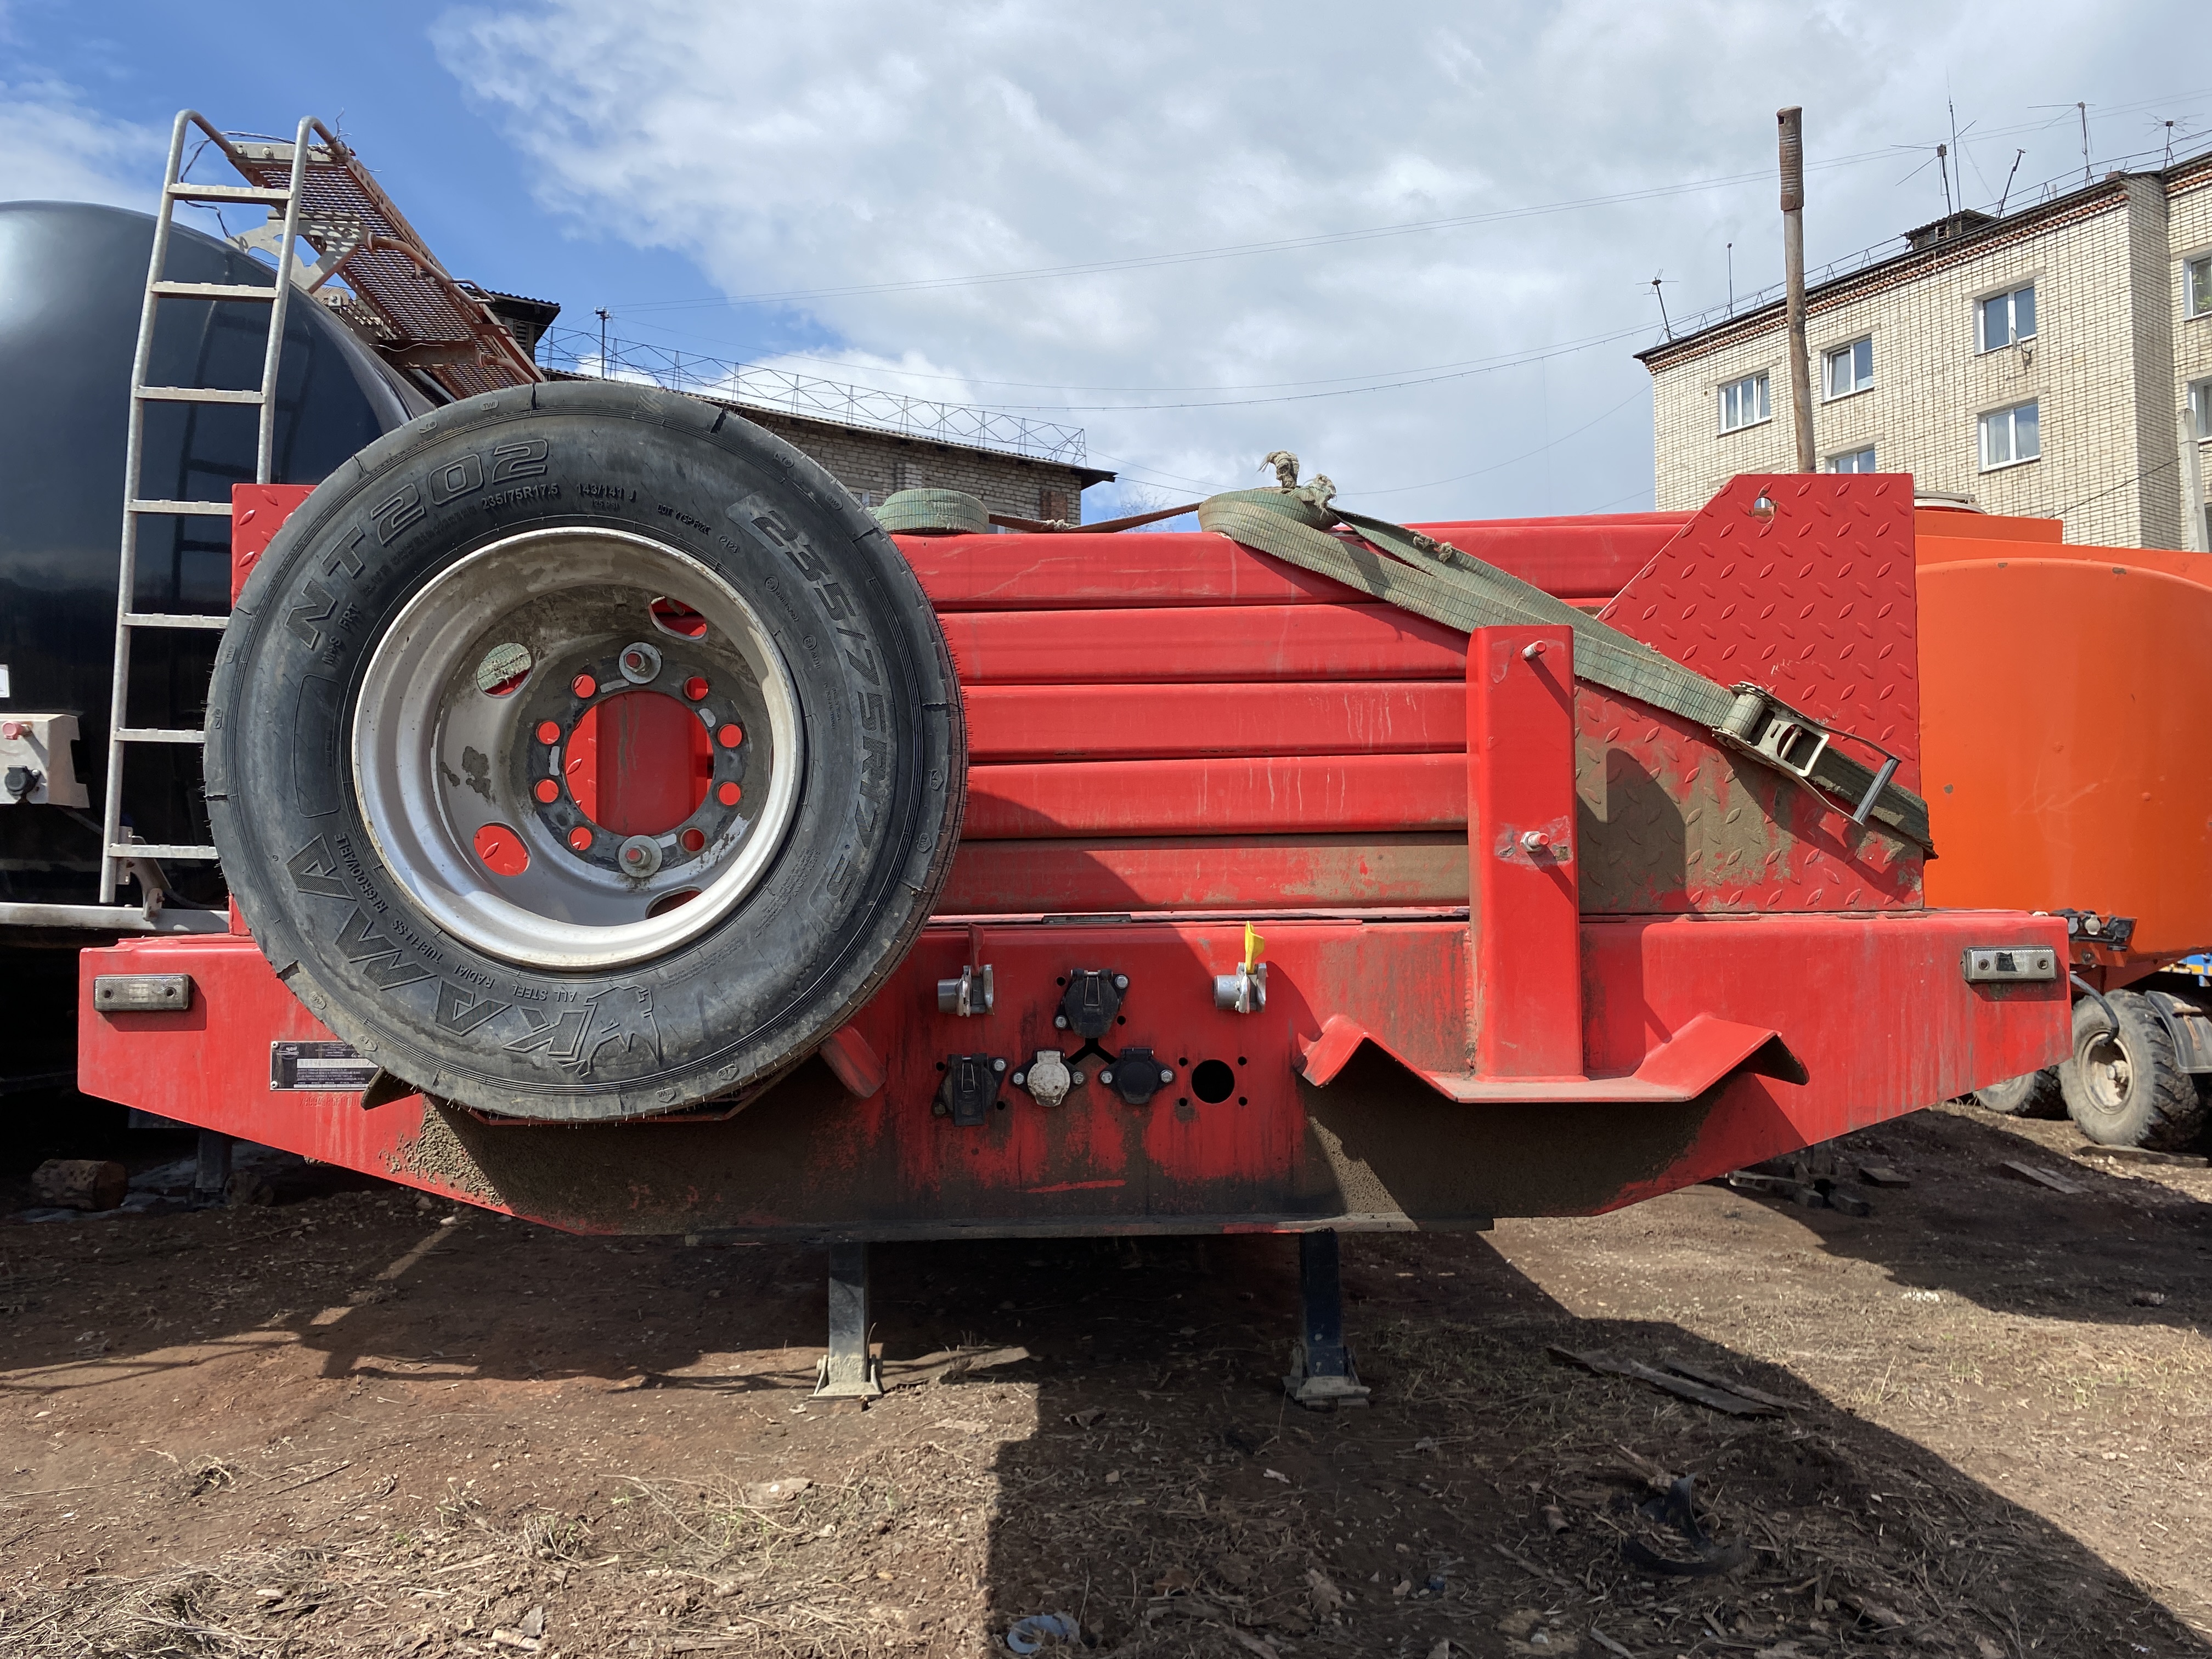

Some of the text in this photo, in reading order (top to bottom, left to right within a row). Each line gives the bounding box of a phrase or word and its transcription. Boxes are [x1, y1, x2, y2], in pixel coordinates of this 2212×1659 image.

[481, 400, 496, 410] TWI
[481, 482, 558, 511] 235/75R17.5
[576, 483, 625, 499] 143/141
[825, 494, 842, 509] TWI
[657, 503, 673, 517] DOT
[719, 535, 740, 554] 2123
[337, 602, 361, 630] FRT
[225, 645, 235, 661] TWI
[321, 635, 341, 665] M+S
[751, 510, 887, 904] 235/75R17.5
[918, 834, 928, 849] TWI
[336, 833, 388, 913] REGROOVABLE
[286, 833, 588, 1056] KAMA
[453, 963, 495, 990] RADIAL
[511, 984, 548, 1002] STEEL
[553, 990, 577, 1002] ALL
